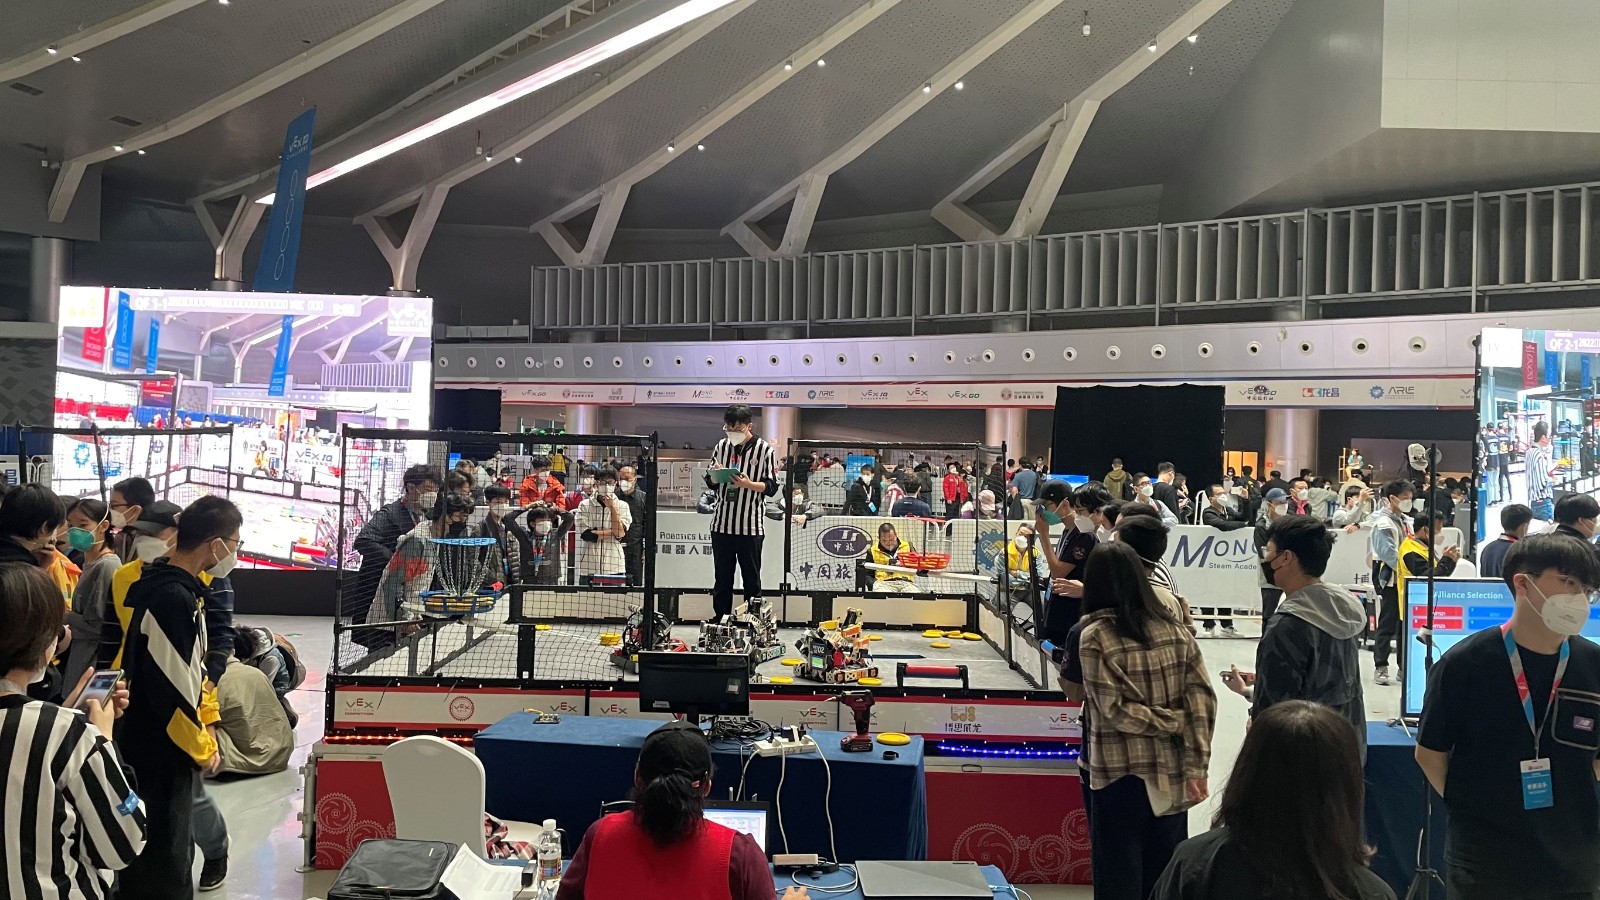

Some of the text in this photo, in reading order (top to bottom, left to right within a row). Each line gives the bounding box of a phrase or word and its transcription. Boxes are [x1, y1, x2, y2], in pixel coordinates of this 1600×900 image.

[907, 388, 928, 396] VEX
[948, 390, 968, 398] VEX
[1388, 386, 1415, 394] ARLE
[296, 448, 320, 460] VEX
[814, 476, 838, 488] VEX
[660, 532, 696, 540] ROBOTICS
[346, 698, 374, 708] VEX
[550, 702, 578, 712] VEX
[600, 704, 628, 714] VEX
[800, 708, 827, 718] VEX
[1050, 713, 1077, 723] VEX
